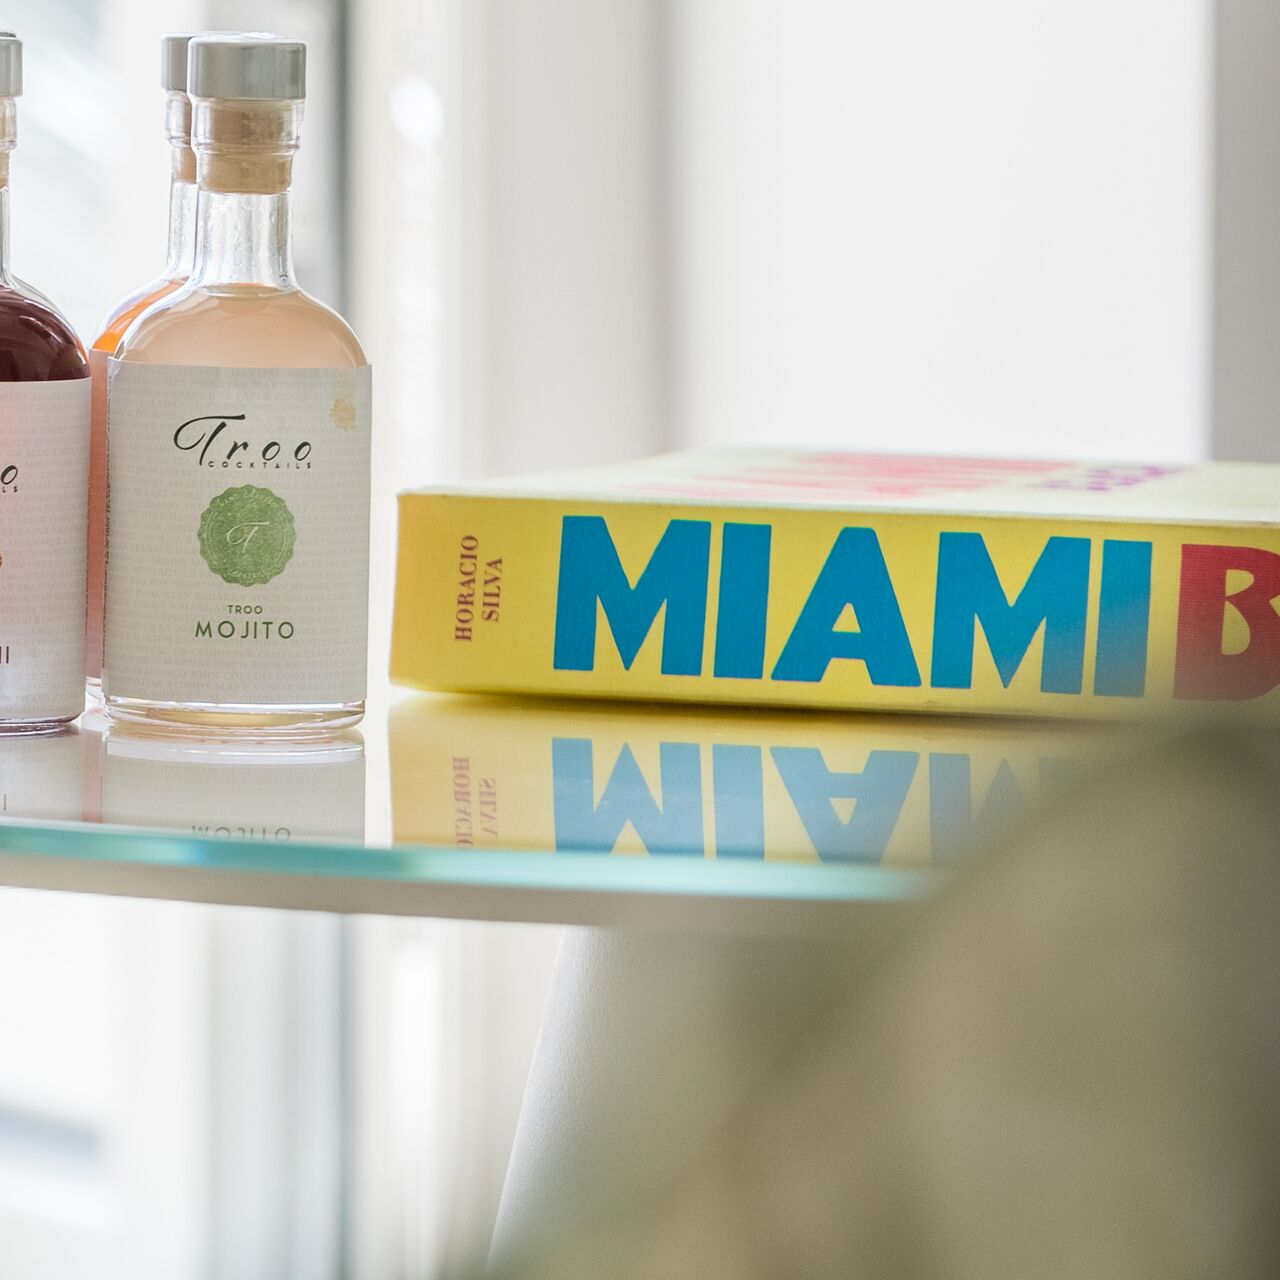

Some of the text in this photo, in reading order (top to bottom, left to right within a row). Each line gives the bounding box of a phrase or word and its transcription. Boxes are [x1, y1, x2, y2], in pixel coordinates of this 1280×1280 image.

[173, 414, 312, 466] Troo
[208, 460, 312, 469] COCKTAILS
[227, 604, 263, 615] TROO
[454, 534, 479, 642] HORACIO
[481, 557, 504, 622] SILVA
[553, 515, 1153, 698] MIAMI
[195, 620, 295, 640] MOJITO
